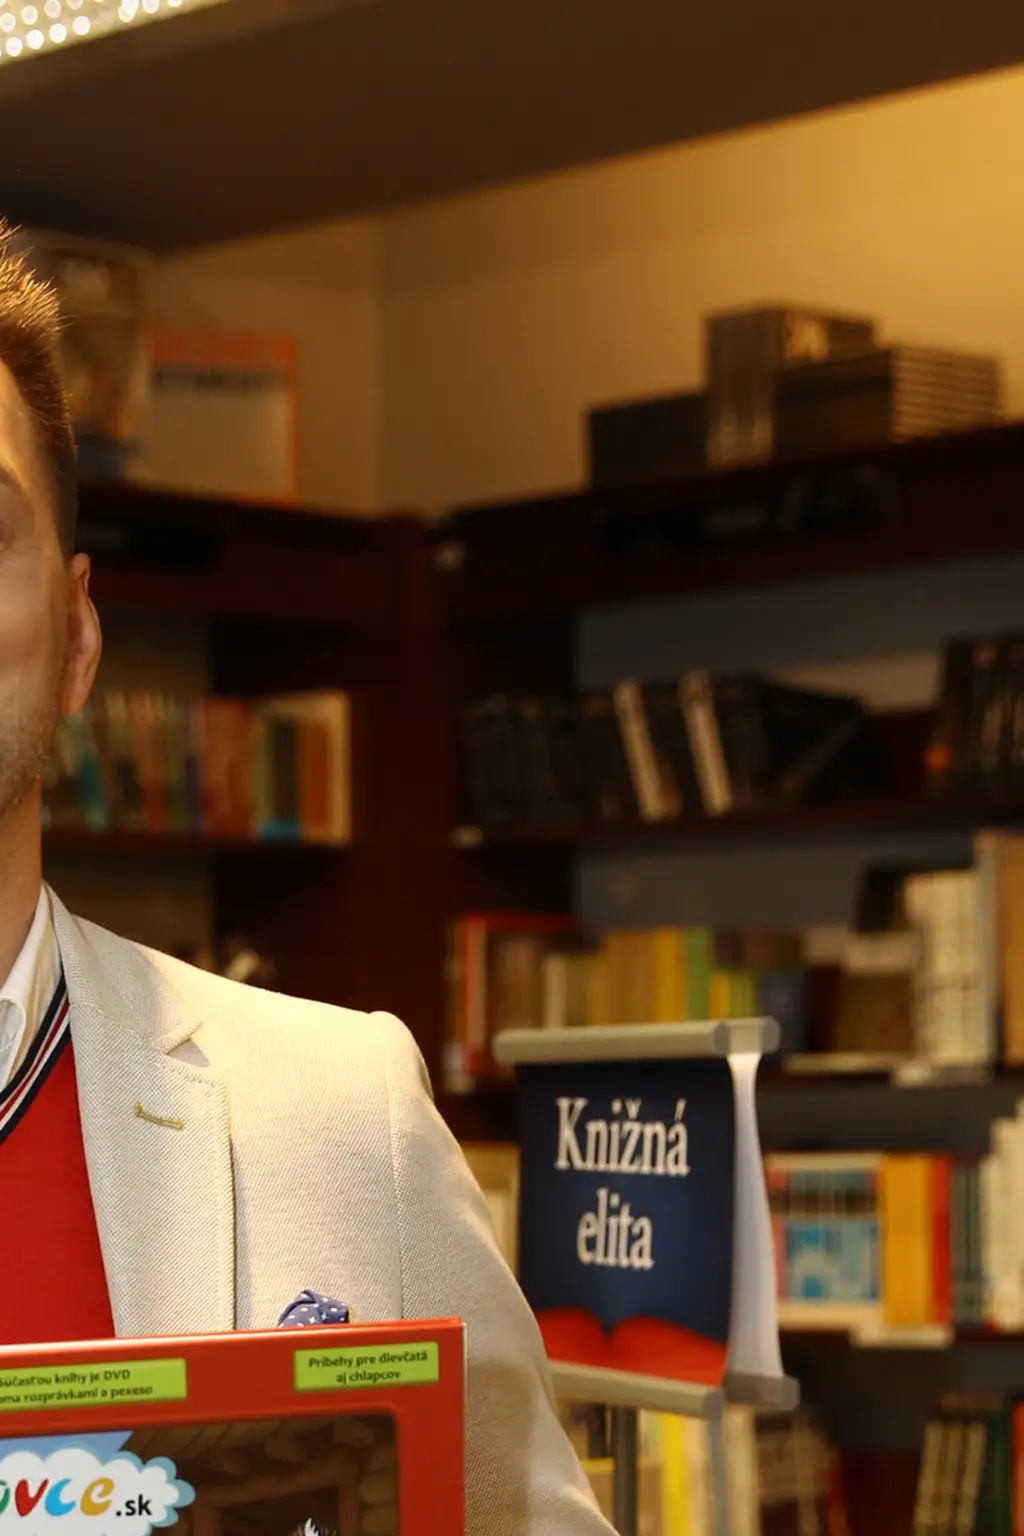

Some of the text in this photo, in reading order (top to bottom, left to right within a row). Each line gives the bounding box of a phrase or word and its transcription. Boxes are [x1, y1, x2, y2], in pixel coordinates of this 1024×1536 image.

[553, 1096, 691, 1177] Knižná
[576, 1186, 655, 1271] elita
[356, 1355, 376, 1367] pre
[54, 1372, 87, 1386] knihy
[89, 1371, 101, 1384] je
[104, 1369, 131, 1381] DVD
[336, 1370, 401, 1384] aj chlapcov
[23, 1387, 98, 1404] rozprávkami
[110, 1385, 153, 1399] pexeso
